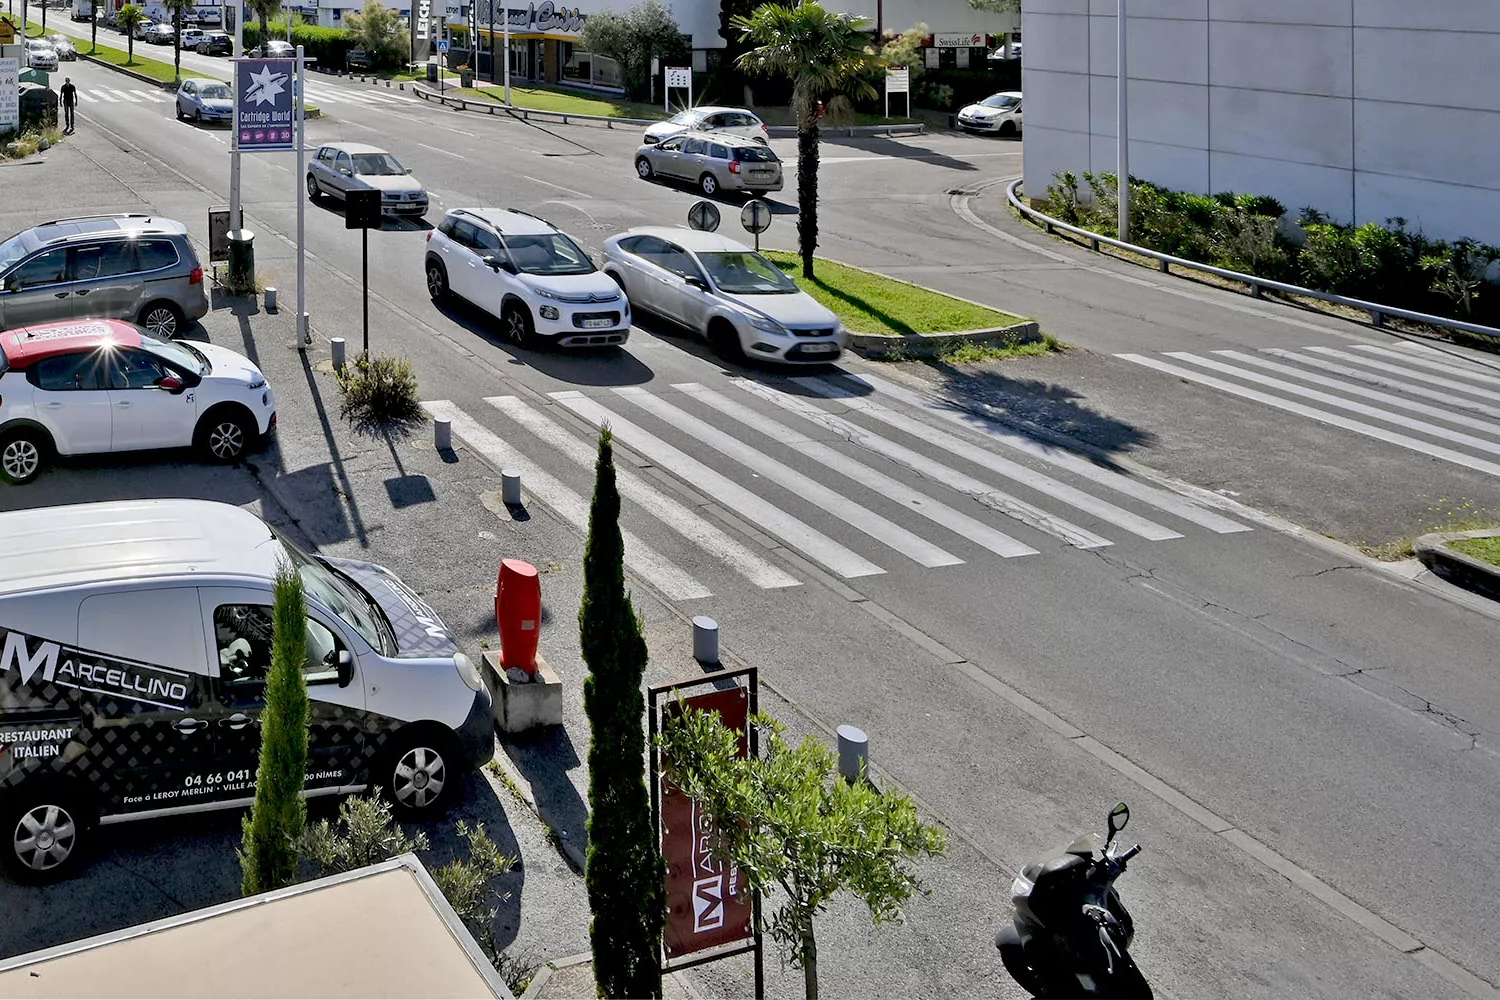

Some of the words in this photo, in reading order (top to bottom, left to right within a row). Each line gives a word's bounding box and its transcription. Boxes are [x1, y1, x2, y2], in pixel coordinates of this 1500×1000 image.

[938, 36, 970, 46] SwissLife
[241, 111, 270, 123] Cartridge
[271, 110, 291, 121] World
[0, 631, 187, 701] MARCELLINO
[14, 744, 60, 759] ITALIEN
[185, 773, 201, 787] 04
[206, 772, 222, 785] 66
[227, 769, 250, 783] 041
[124, 795, 142, 804] Face
[153, 790, 180, 800] LEROY
[181, 786, 213, 797] MERLIN
[223, 783, 245, 792] VILLE
